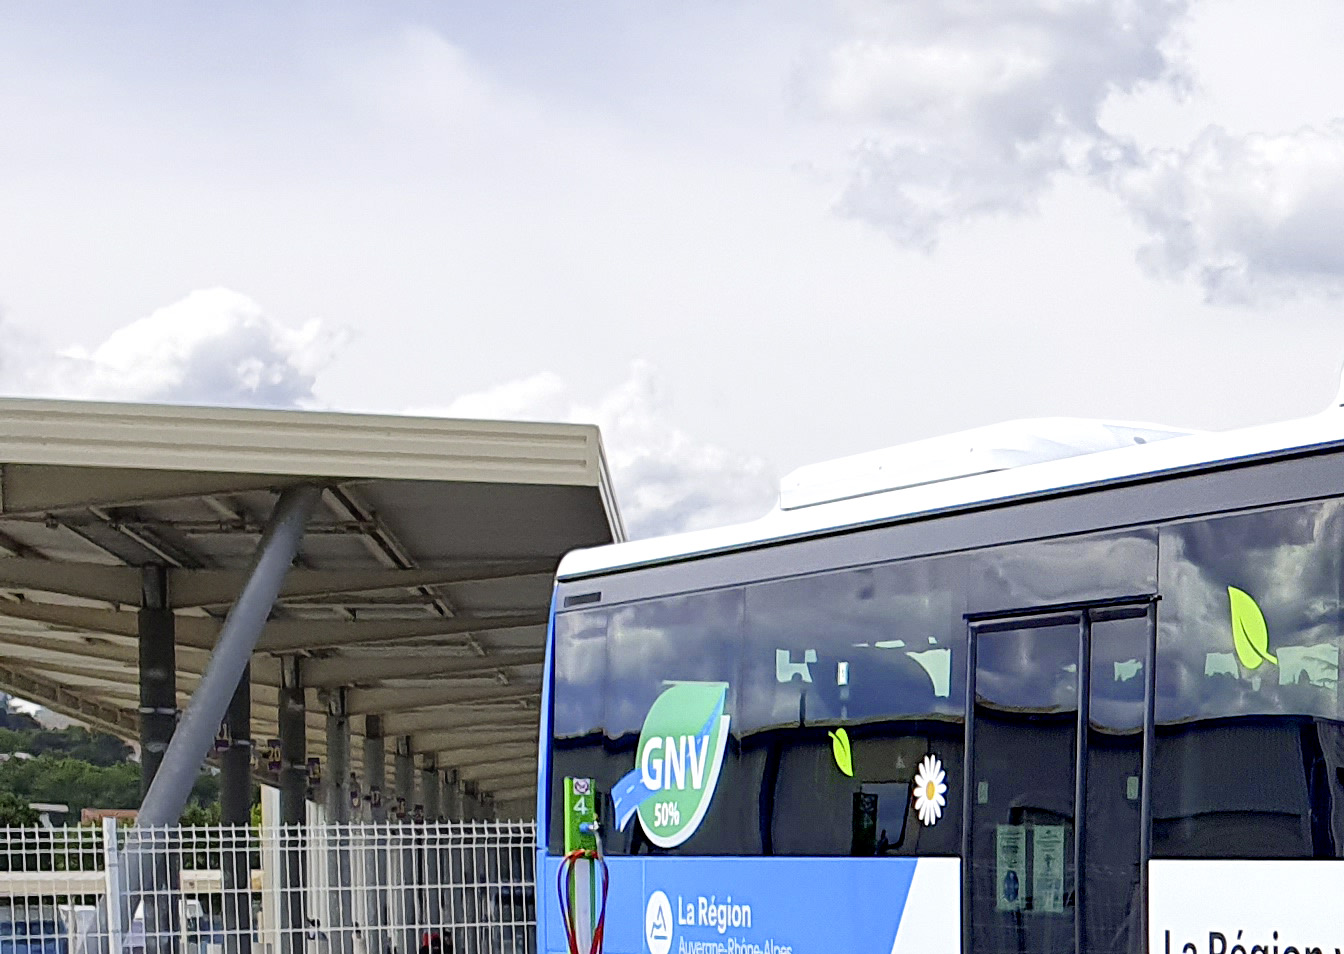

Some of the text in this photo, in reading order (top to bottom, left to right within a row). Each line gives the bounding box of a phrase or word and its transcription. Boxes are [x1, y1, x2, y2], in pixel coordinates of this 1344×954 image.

[642, 735, 710, 790] GNV
[573, 796, 589, 816] 4
[654, 801, 680, 827] 50%
[678, 894, 751, 934] La Région
